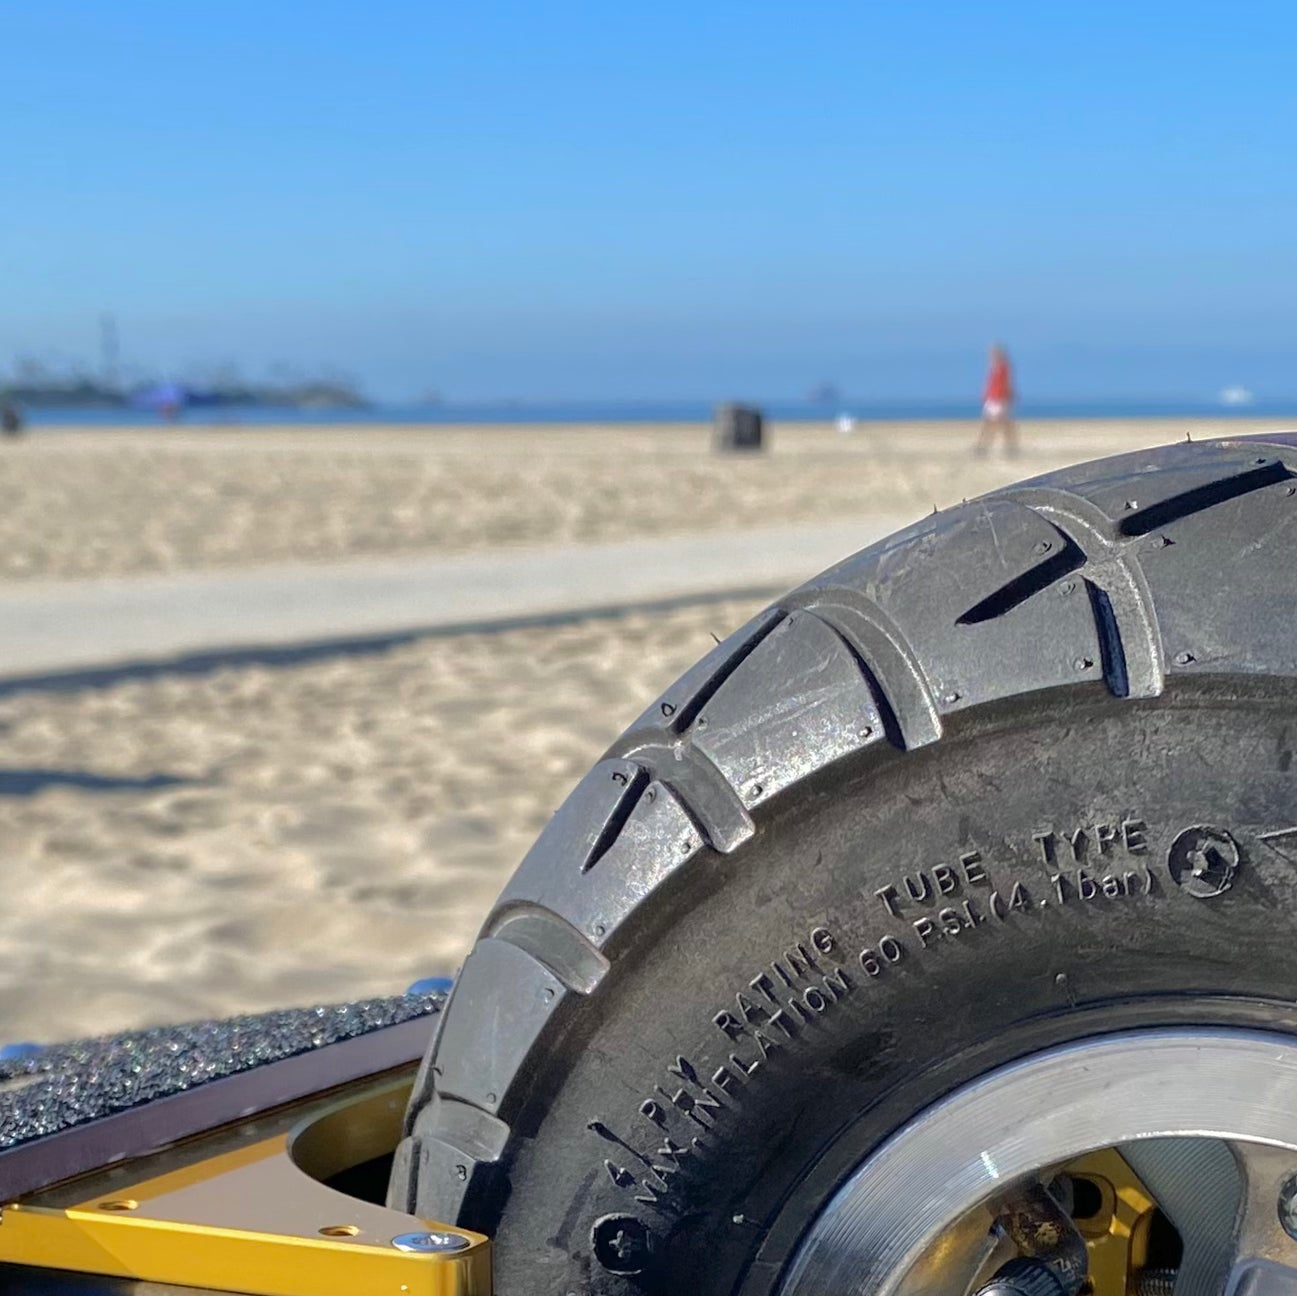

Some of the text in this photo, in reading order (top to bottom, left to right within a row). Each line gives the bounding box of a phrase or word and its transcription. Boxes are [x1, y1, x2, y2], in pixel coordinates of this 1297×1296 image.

[638, 1055, 705, 1132] PLY
[711, 926, 836, 1042] RATING
[873, 850, 988, 917] TUBE
[1031, 817, 1149, 865] TYPE
[859, 934, 901, 977] 60
